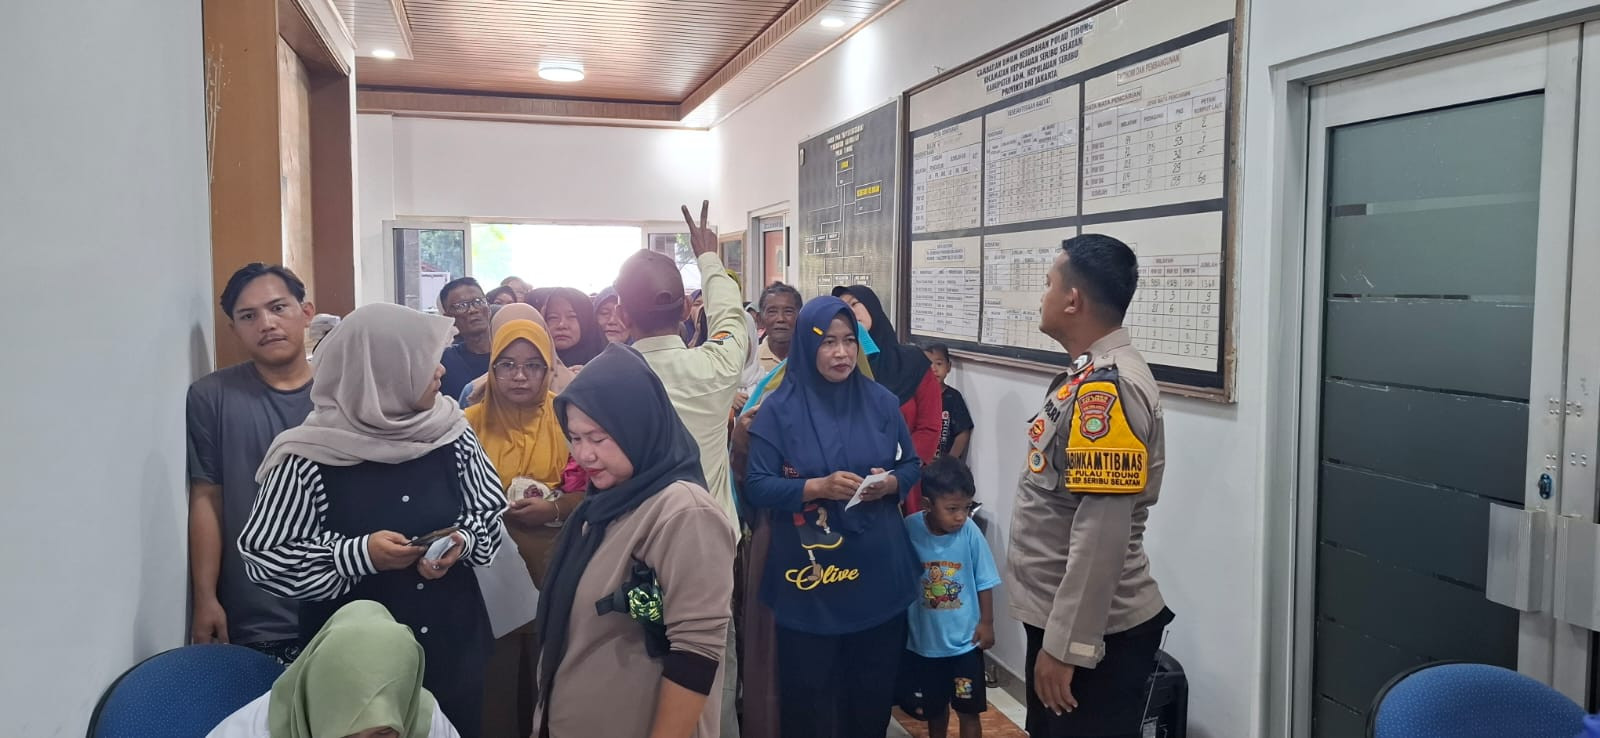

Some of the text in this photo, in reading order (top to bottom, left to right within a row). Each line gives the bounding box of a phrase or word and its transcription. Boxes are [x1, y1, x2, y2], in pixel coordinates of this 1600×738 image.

[1035, 70, 1057, 86] JAKARTA
[1044, 398, 1061, 423] POLRI
[1075, 470, 1103, 478] PULAU
[1106, 471, 1140, 479] TIDUNG
[1083, 477, 1109, 485] SERIBU
[1110, 478, 1141, 486] SELATAN
[785, 563, 860, 591] Olive
